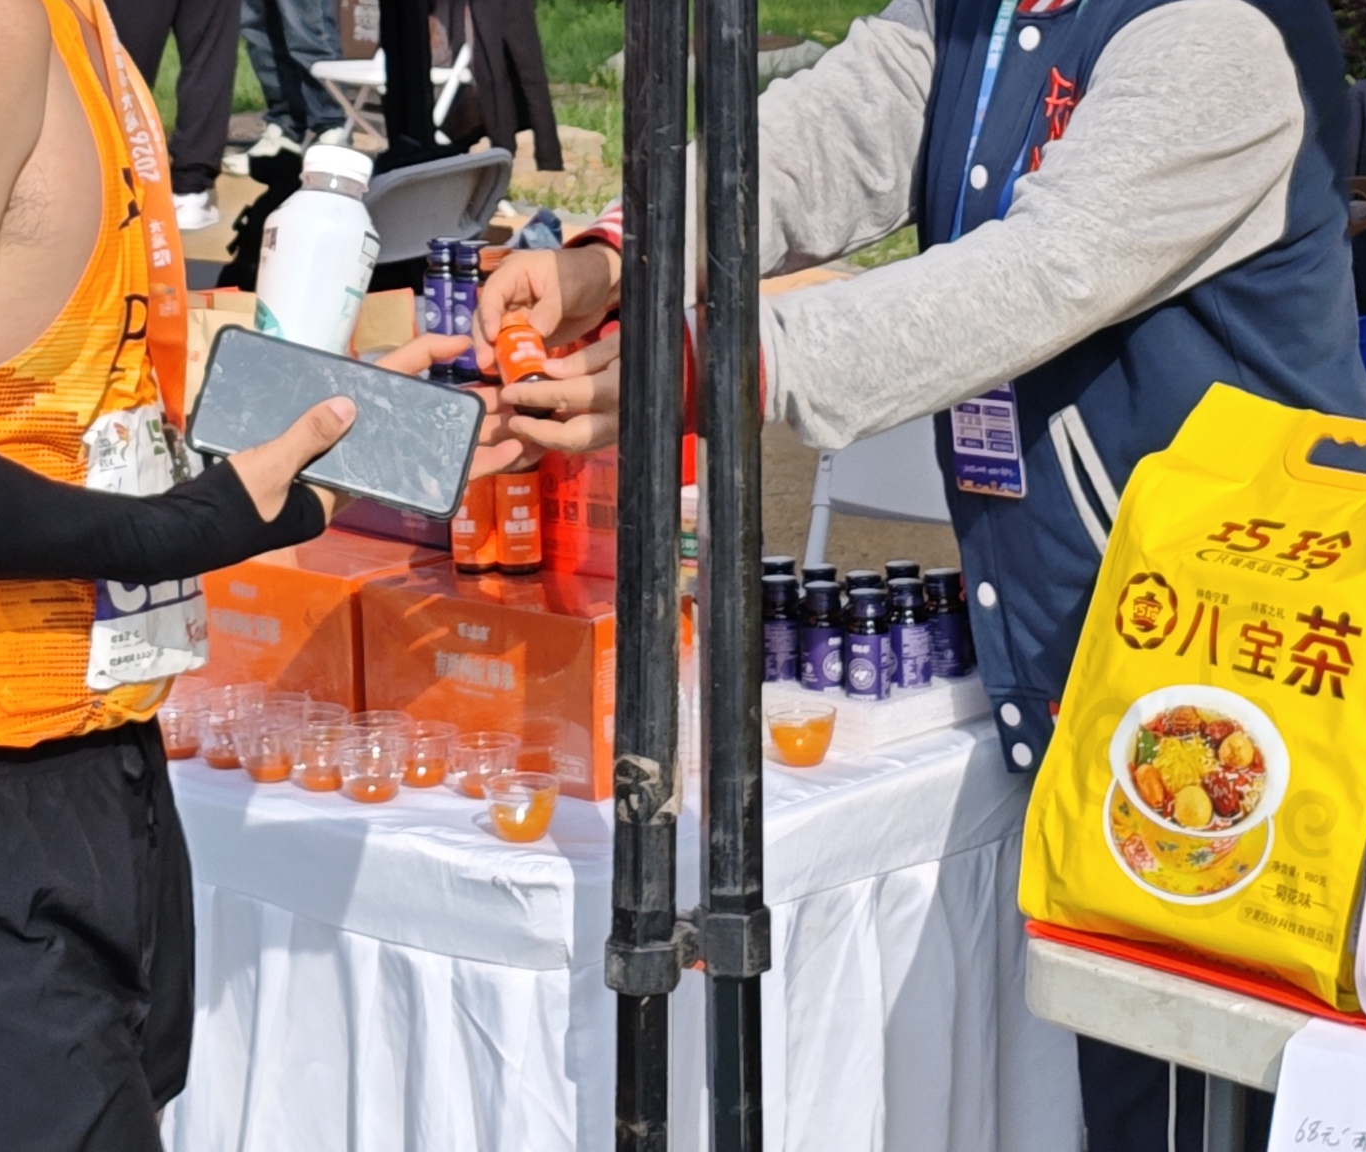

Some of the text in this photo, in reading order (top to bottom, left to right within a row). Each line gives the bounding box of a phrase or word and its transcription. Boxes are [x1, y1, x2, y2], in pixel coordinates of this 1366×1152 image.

[1206, 518, 1352, 570] 巧玲
[1175, 601, 1363, 701] 八宝茶
[1274, 883, 1313, 909] 菊花味
